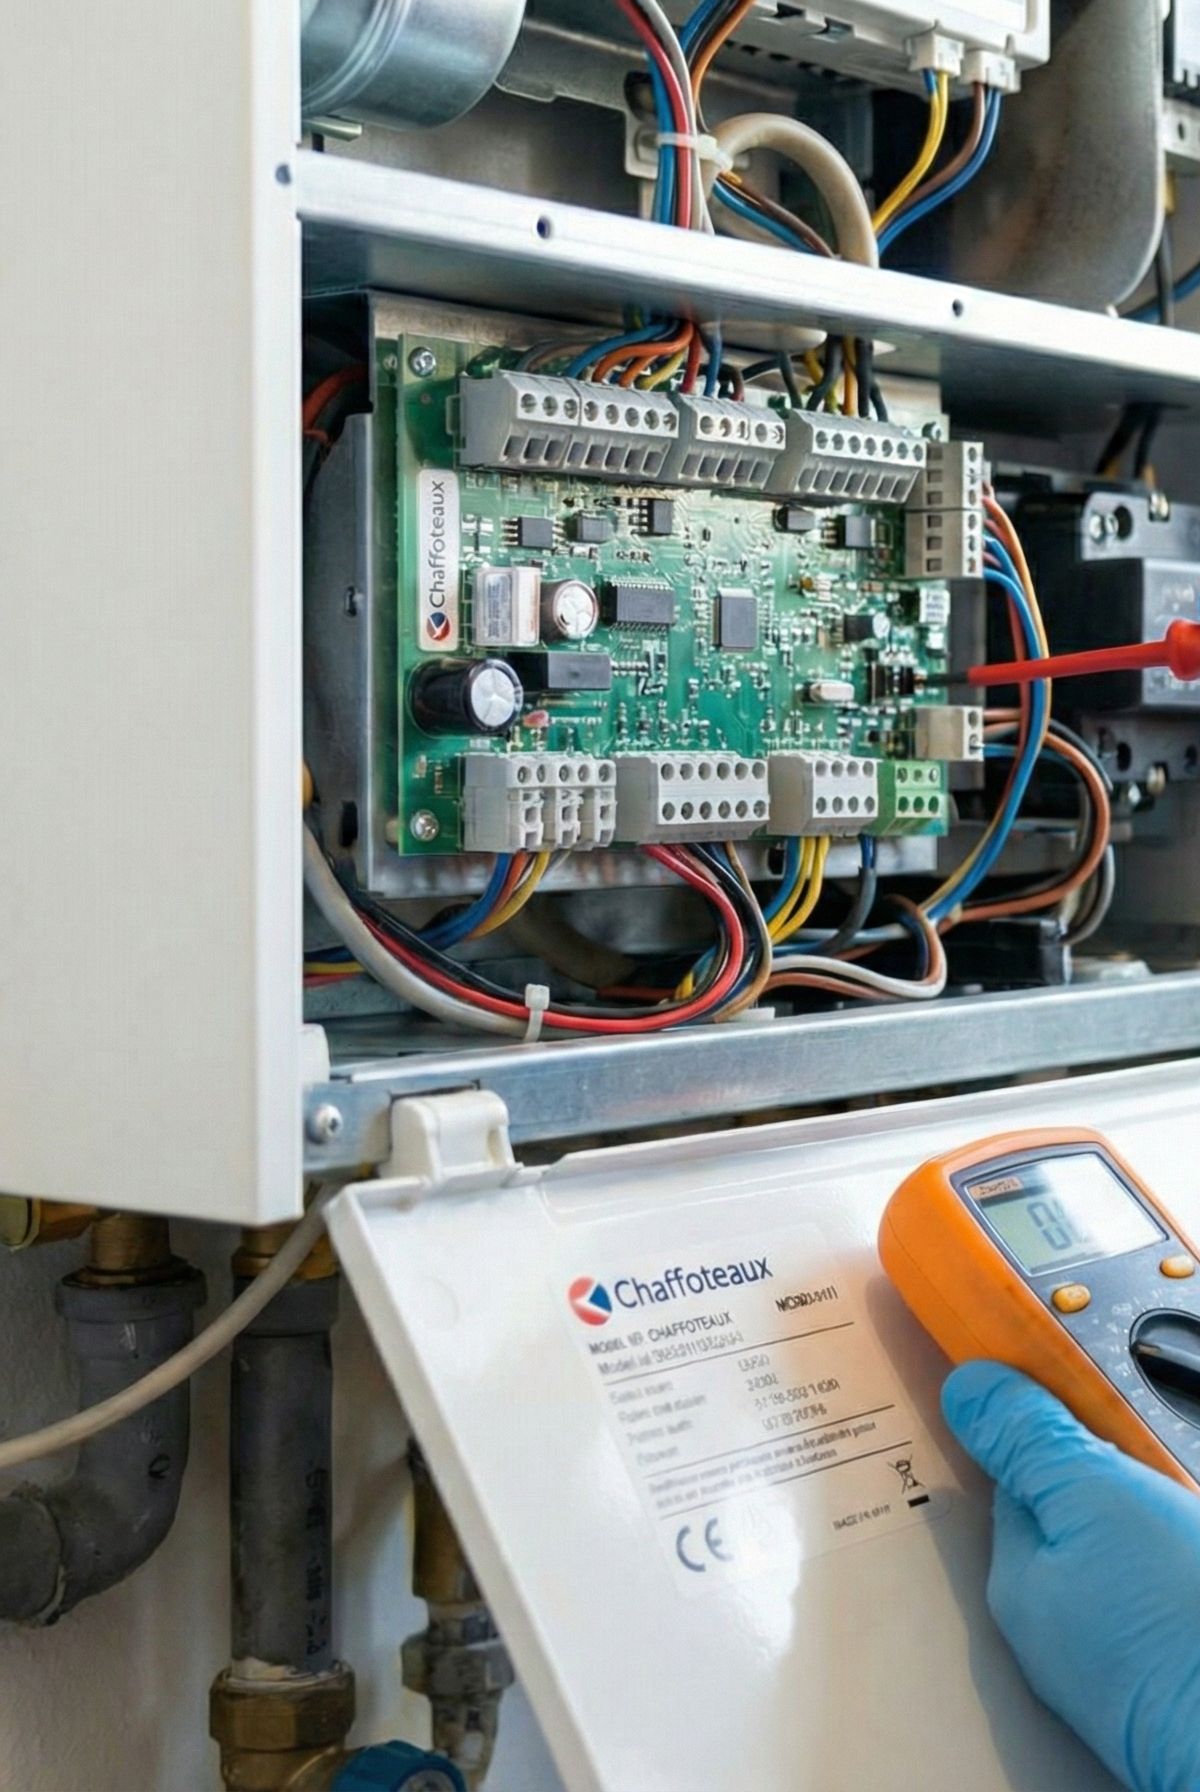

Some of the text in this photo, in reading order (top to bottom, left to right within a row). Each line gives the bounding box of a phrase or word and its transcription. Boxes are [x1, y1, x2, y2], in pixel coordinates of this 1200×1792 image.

[428, 480, 446, 608] Chaffoteaux
[614, 1257, 773, 1309] Chaffoteaux
[647, 1312, 734, 1342] CHAFFOTEAUX
